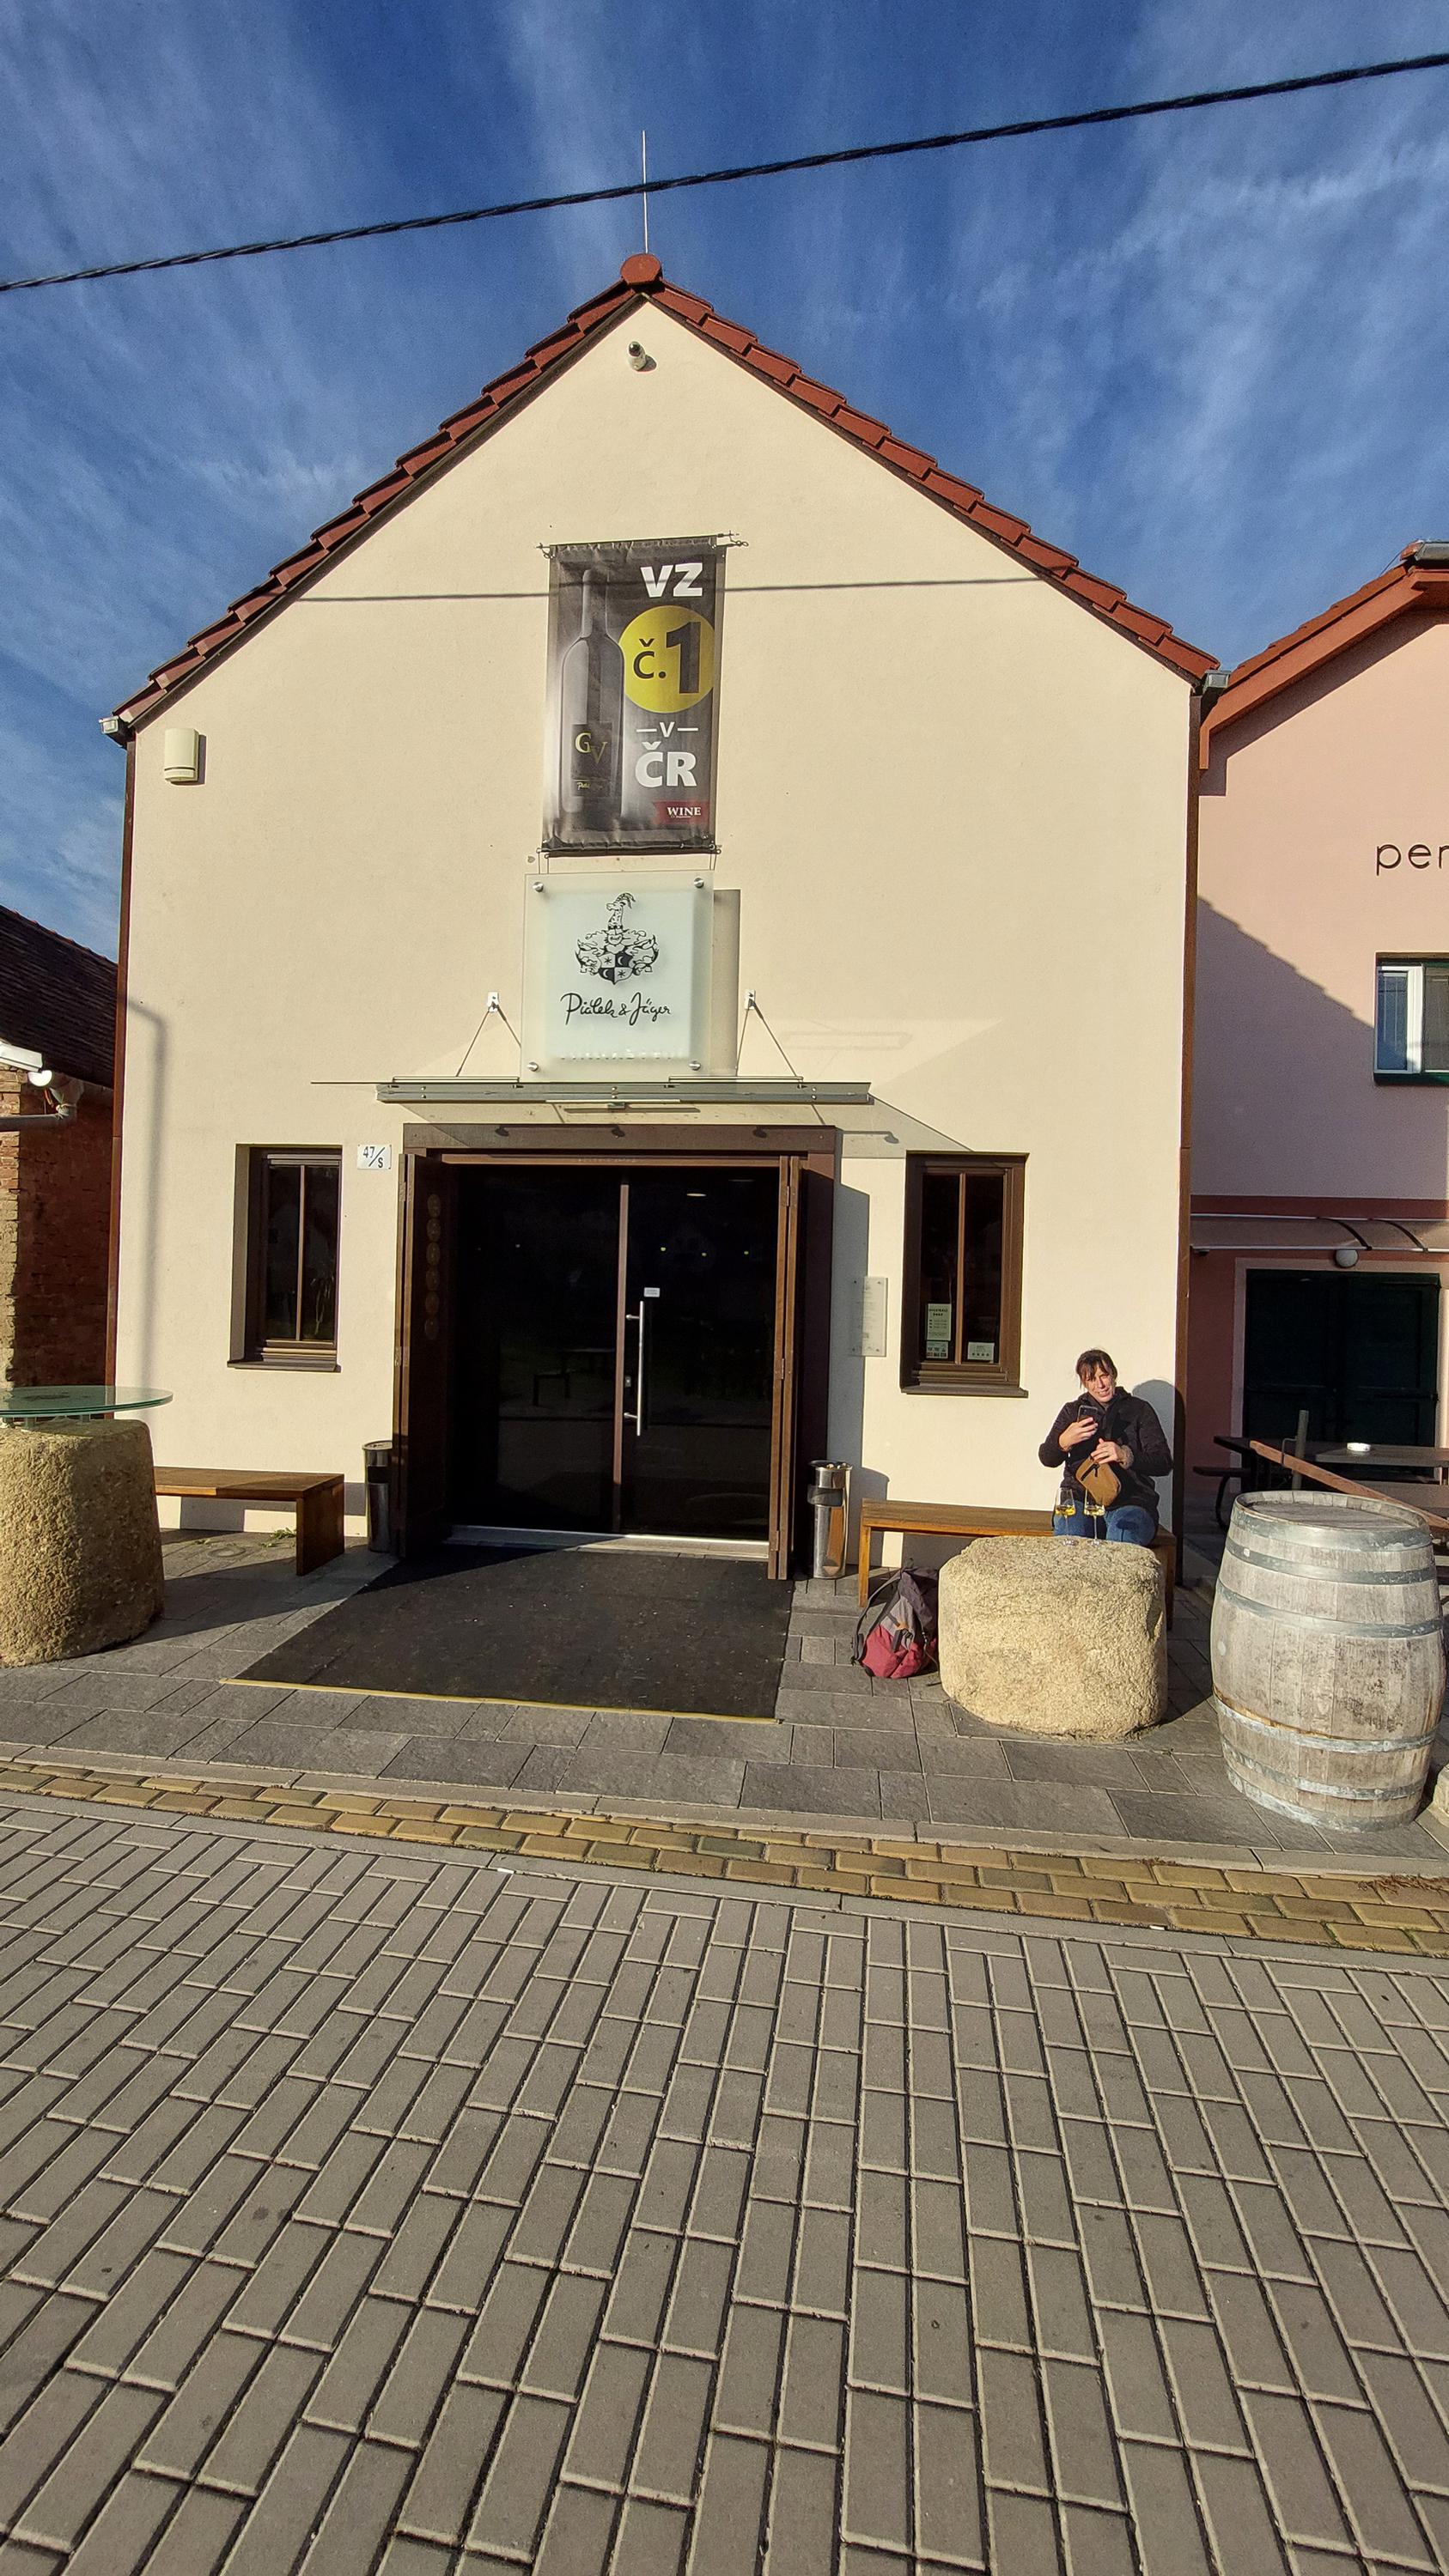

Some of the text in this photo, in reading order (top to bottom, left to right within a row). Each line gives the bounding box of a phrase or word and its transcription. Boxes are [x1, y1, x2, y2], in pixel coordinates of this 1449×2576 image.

[640, 562, 703, 598] VZ
[635, 741, 697, 788] ČR
[667, 806, 702, 816] WINE
[618, 1003, 632, 1016] &
[630, 992, 671, 1026] Jäger
